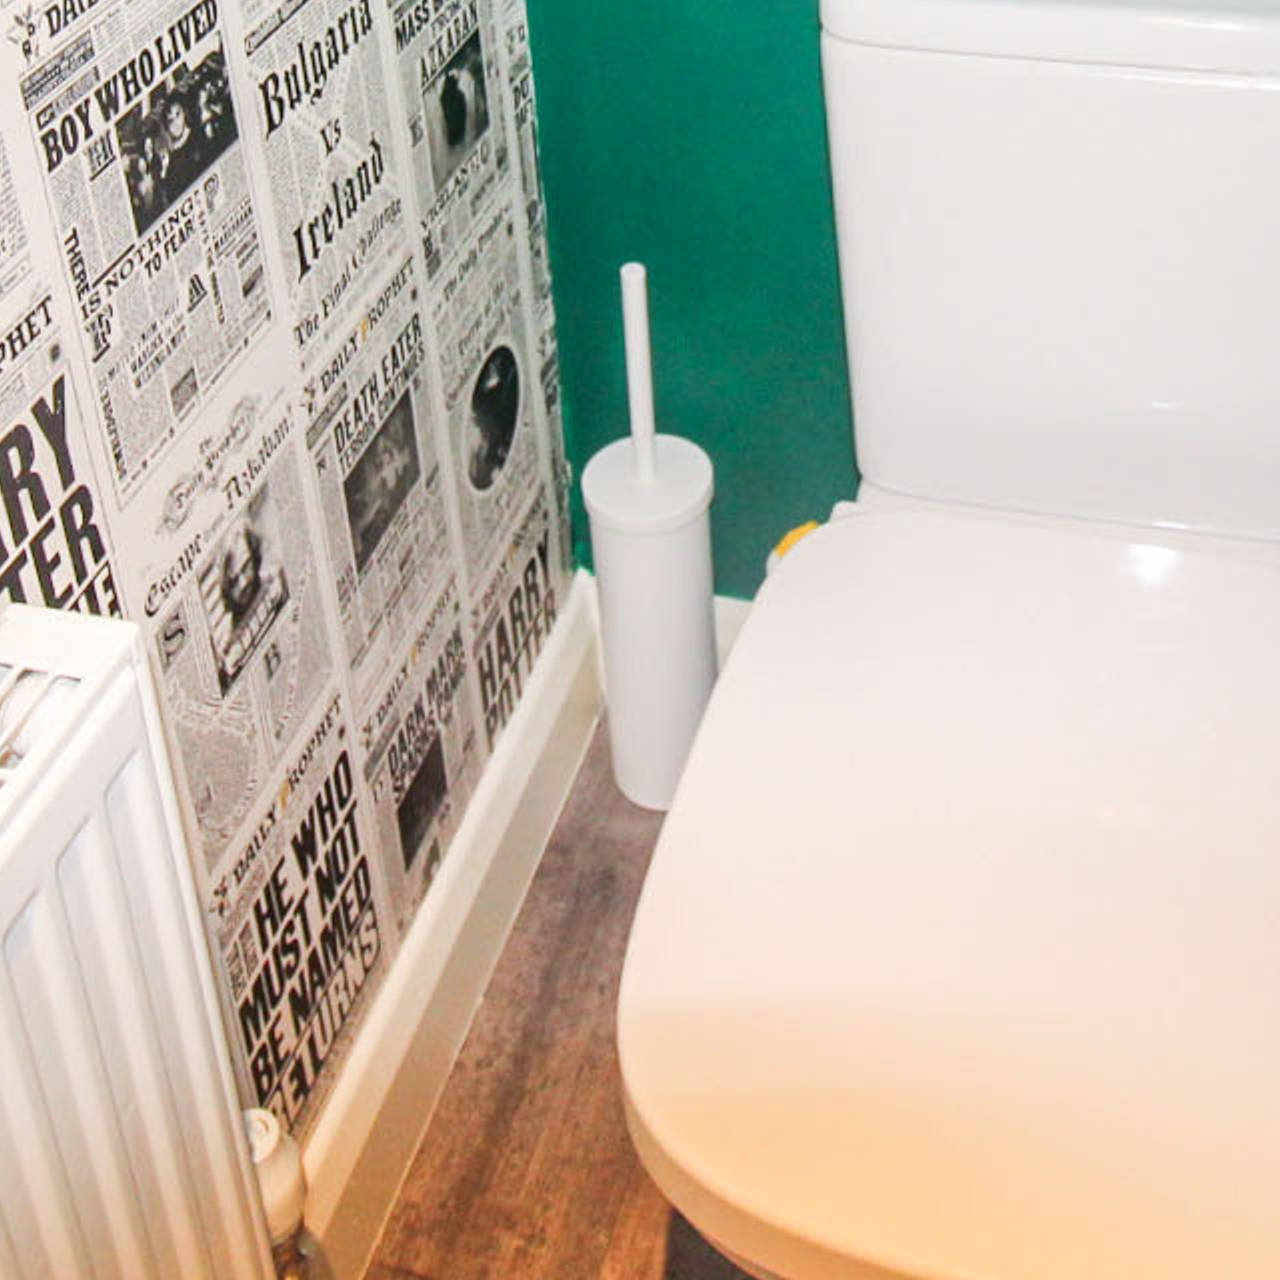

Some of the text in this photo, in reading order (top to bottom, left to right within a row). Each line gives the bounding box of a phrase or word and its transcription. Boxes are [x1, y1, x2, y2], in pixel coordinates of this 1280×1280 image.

[40, 97, 94, 176] BOY
[93, 47, 155, 124] WHO
[63, 226, 93, 303] THERE
[105, 194, 195, 297] NOTHING
[144, 253, 163, 280] TO
[162, 217, 195, 261] FEAR
[292, 130, 384, 284] Ireland
[477, 527, 553, 712] HARRY
[253, 749, 355, 956] HE WHO
[237, 799, 362, 1056] MUST NOT
[249, 854, 372, 1108] BE NAMED
